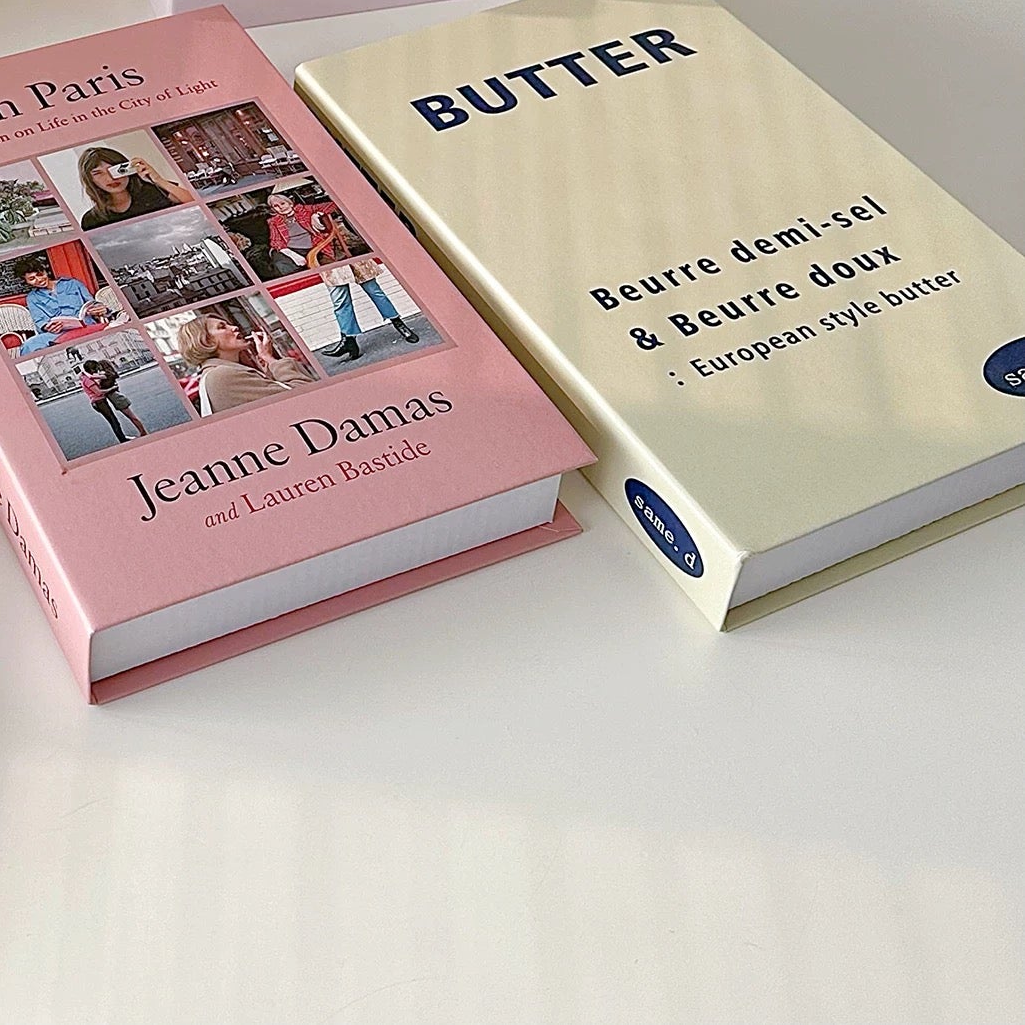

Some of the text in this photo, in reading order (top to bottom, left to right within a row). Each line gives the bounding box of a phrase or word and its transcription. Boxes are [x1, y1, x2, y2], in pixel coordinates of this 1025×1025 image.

[14, 126, 36, 139] on
[35, 115, 70, 133] Life
[71, 112, 90, 125] in
[90, 104, 117, 120] the
[117, 94, 153, 114] City
[154, 87, 173, 103] of
[174, 77, 220, 100] Light
[24, 64, 146, 113] Paris
[408, 27, 699, 133] BUTTER
[587, 194, 889, 312] Beurre demi-sel
[627, 244, 903, 352] & Beurre doux
[688, 323, 818, 379] European
[818, 298, 884, 334] style
[877, 267, 963, 309] butter
[126, 389, 455, 523] Jeanne Damas
[204, 437, 433, 530] and Lauren Bastide
[5, 498, 60, 621] Damas
